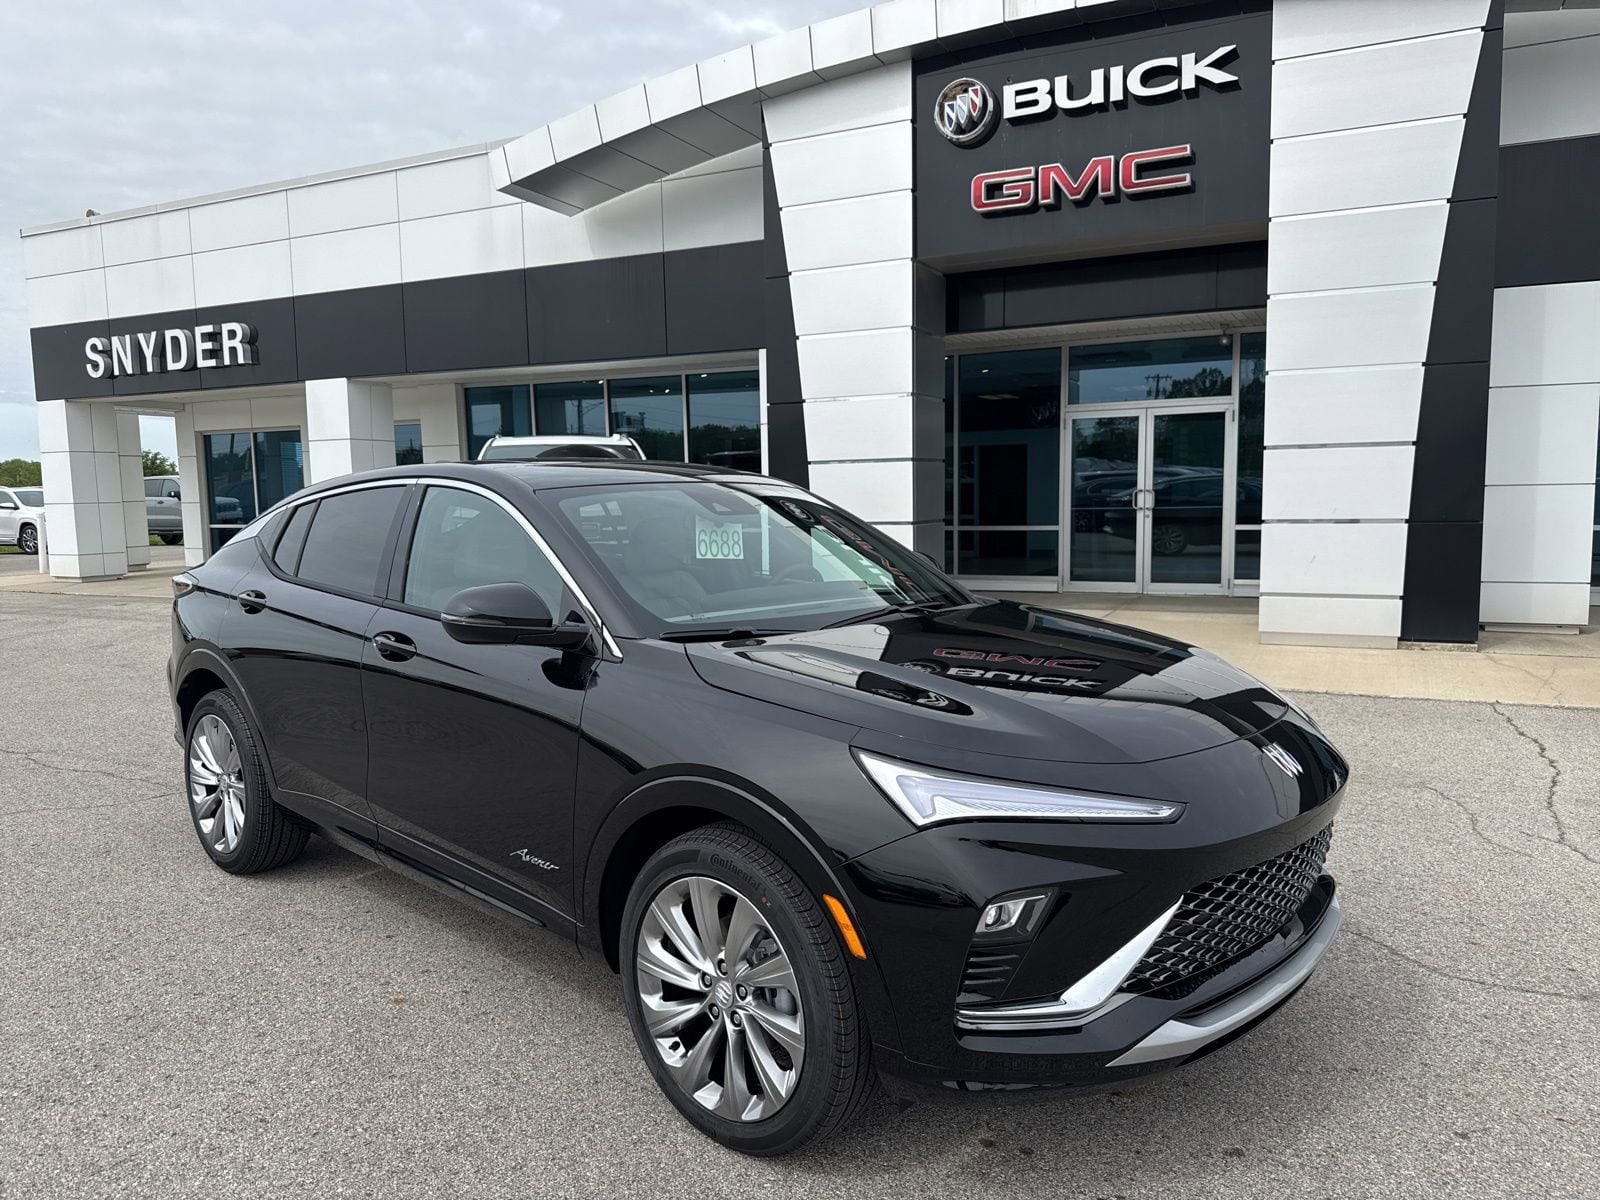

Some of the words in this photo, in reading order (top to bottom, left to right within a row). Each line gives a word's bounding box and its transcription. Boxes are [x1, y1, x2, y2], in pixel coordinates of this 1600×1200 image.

[1003, 44, 1239, 119] BUICK
[971, 144, 1192, 213] GMC
[85, 322, 252, 379] SNYDER
[697, 529, 742, 558] 6688
[509, 848, 560, 870] Avenir
[710, 854, 761, 890] Continental
